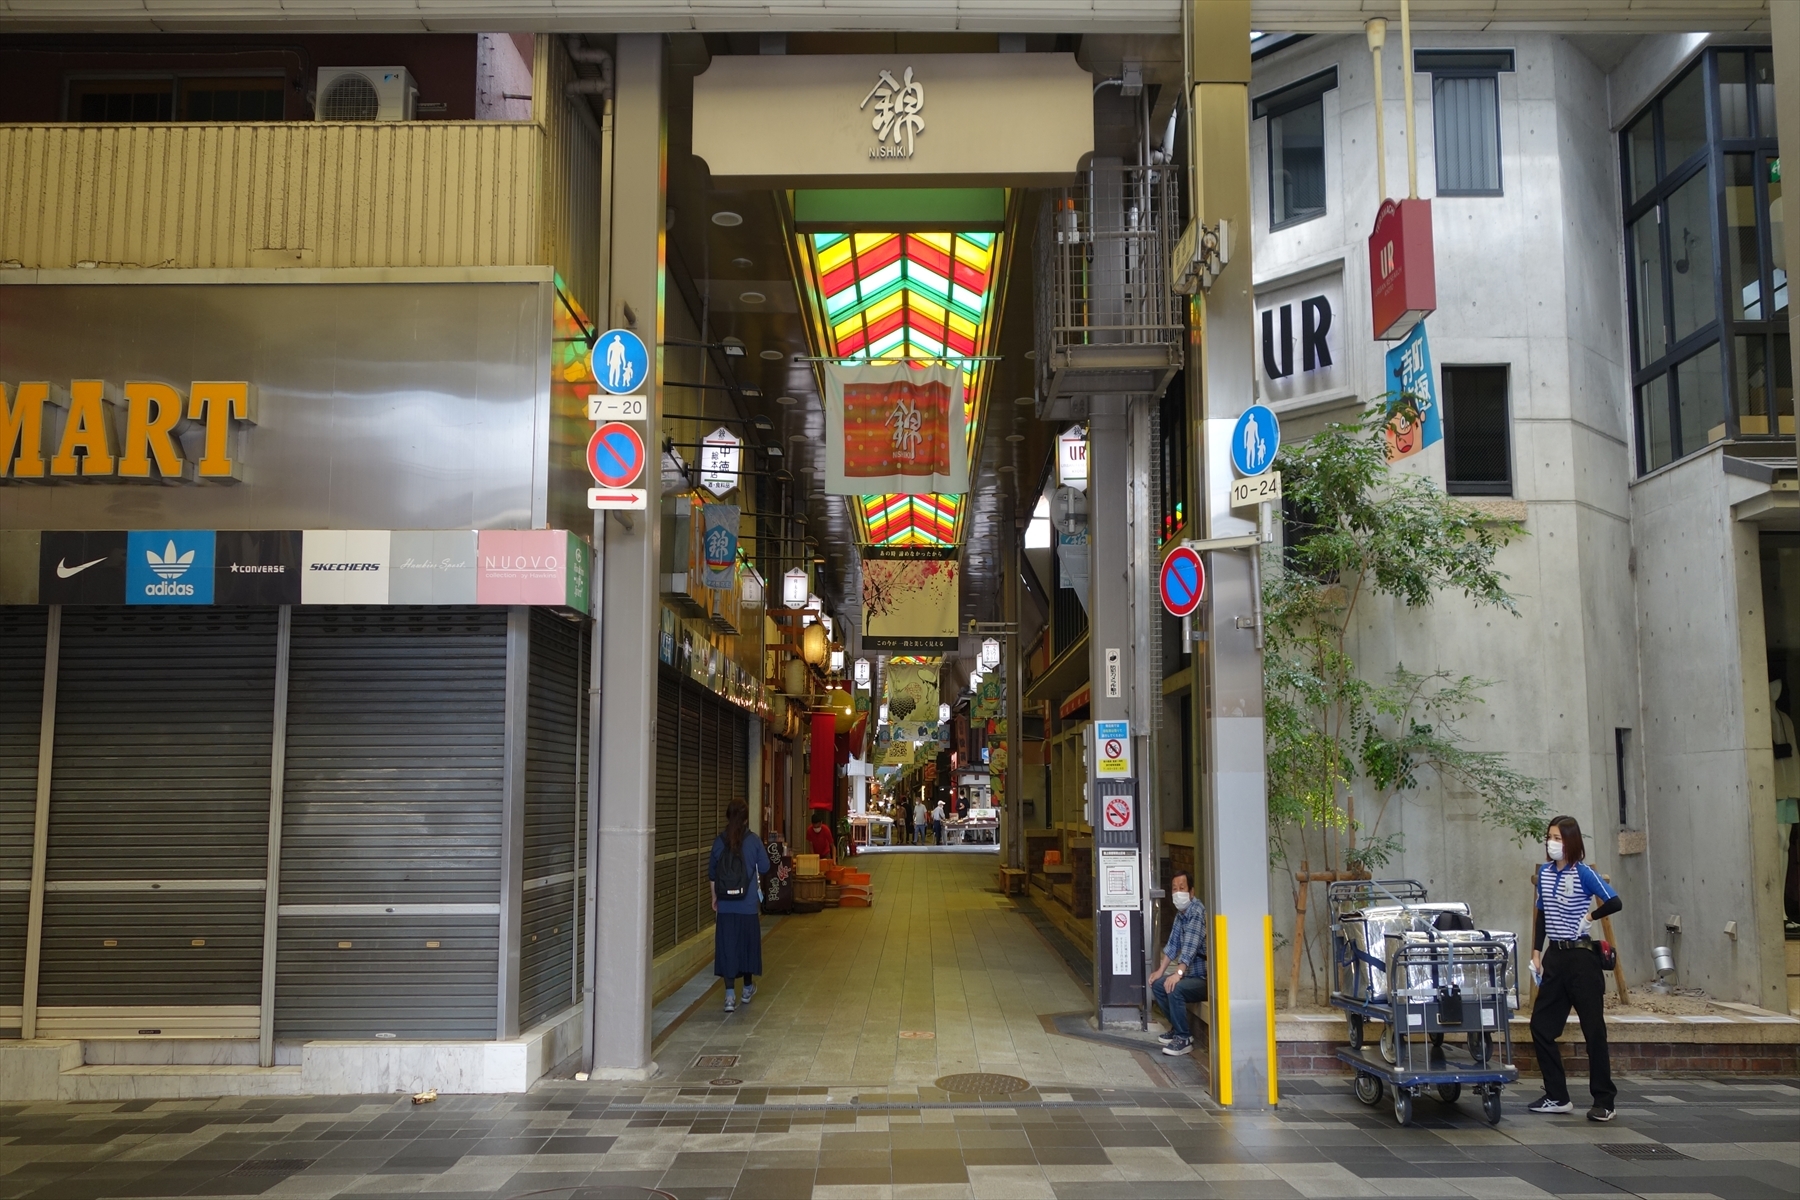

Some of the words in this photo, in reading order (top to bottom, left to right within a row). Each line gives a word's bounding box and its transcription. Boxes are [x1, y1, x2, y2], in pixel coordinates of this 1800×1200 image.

[860, 66, 925, 158] 錦
[868, 146, 907, 158] NISHIKI
[1380, 240, 1394, 280] UR
[1261, 294, 1333, 380] UR
[0, 379, 249, 478] MART
[884, 398, 923, 460] 錦
[1069, 445, 1086, 460] UR
[1234, 477, 1277, 502] 10-24
[485, 555, 557, 570] NUOVO
[706, 530, 729, 565] 錦
[309, 563, 380, 572] SKECHERS
[145, 581, 194, 596] adidas
